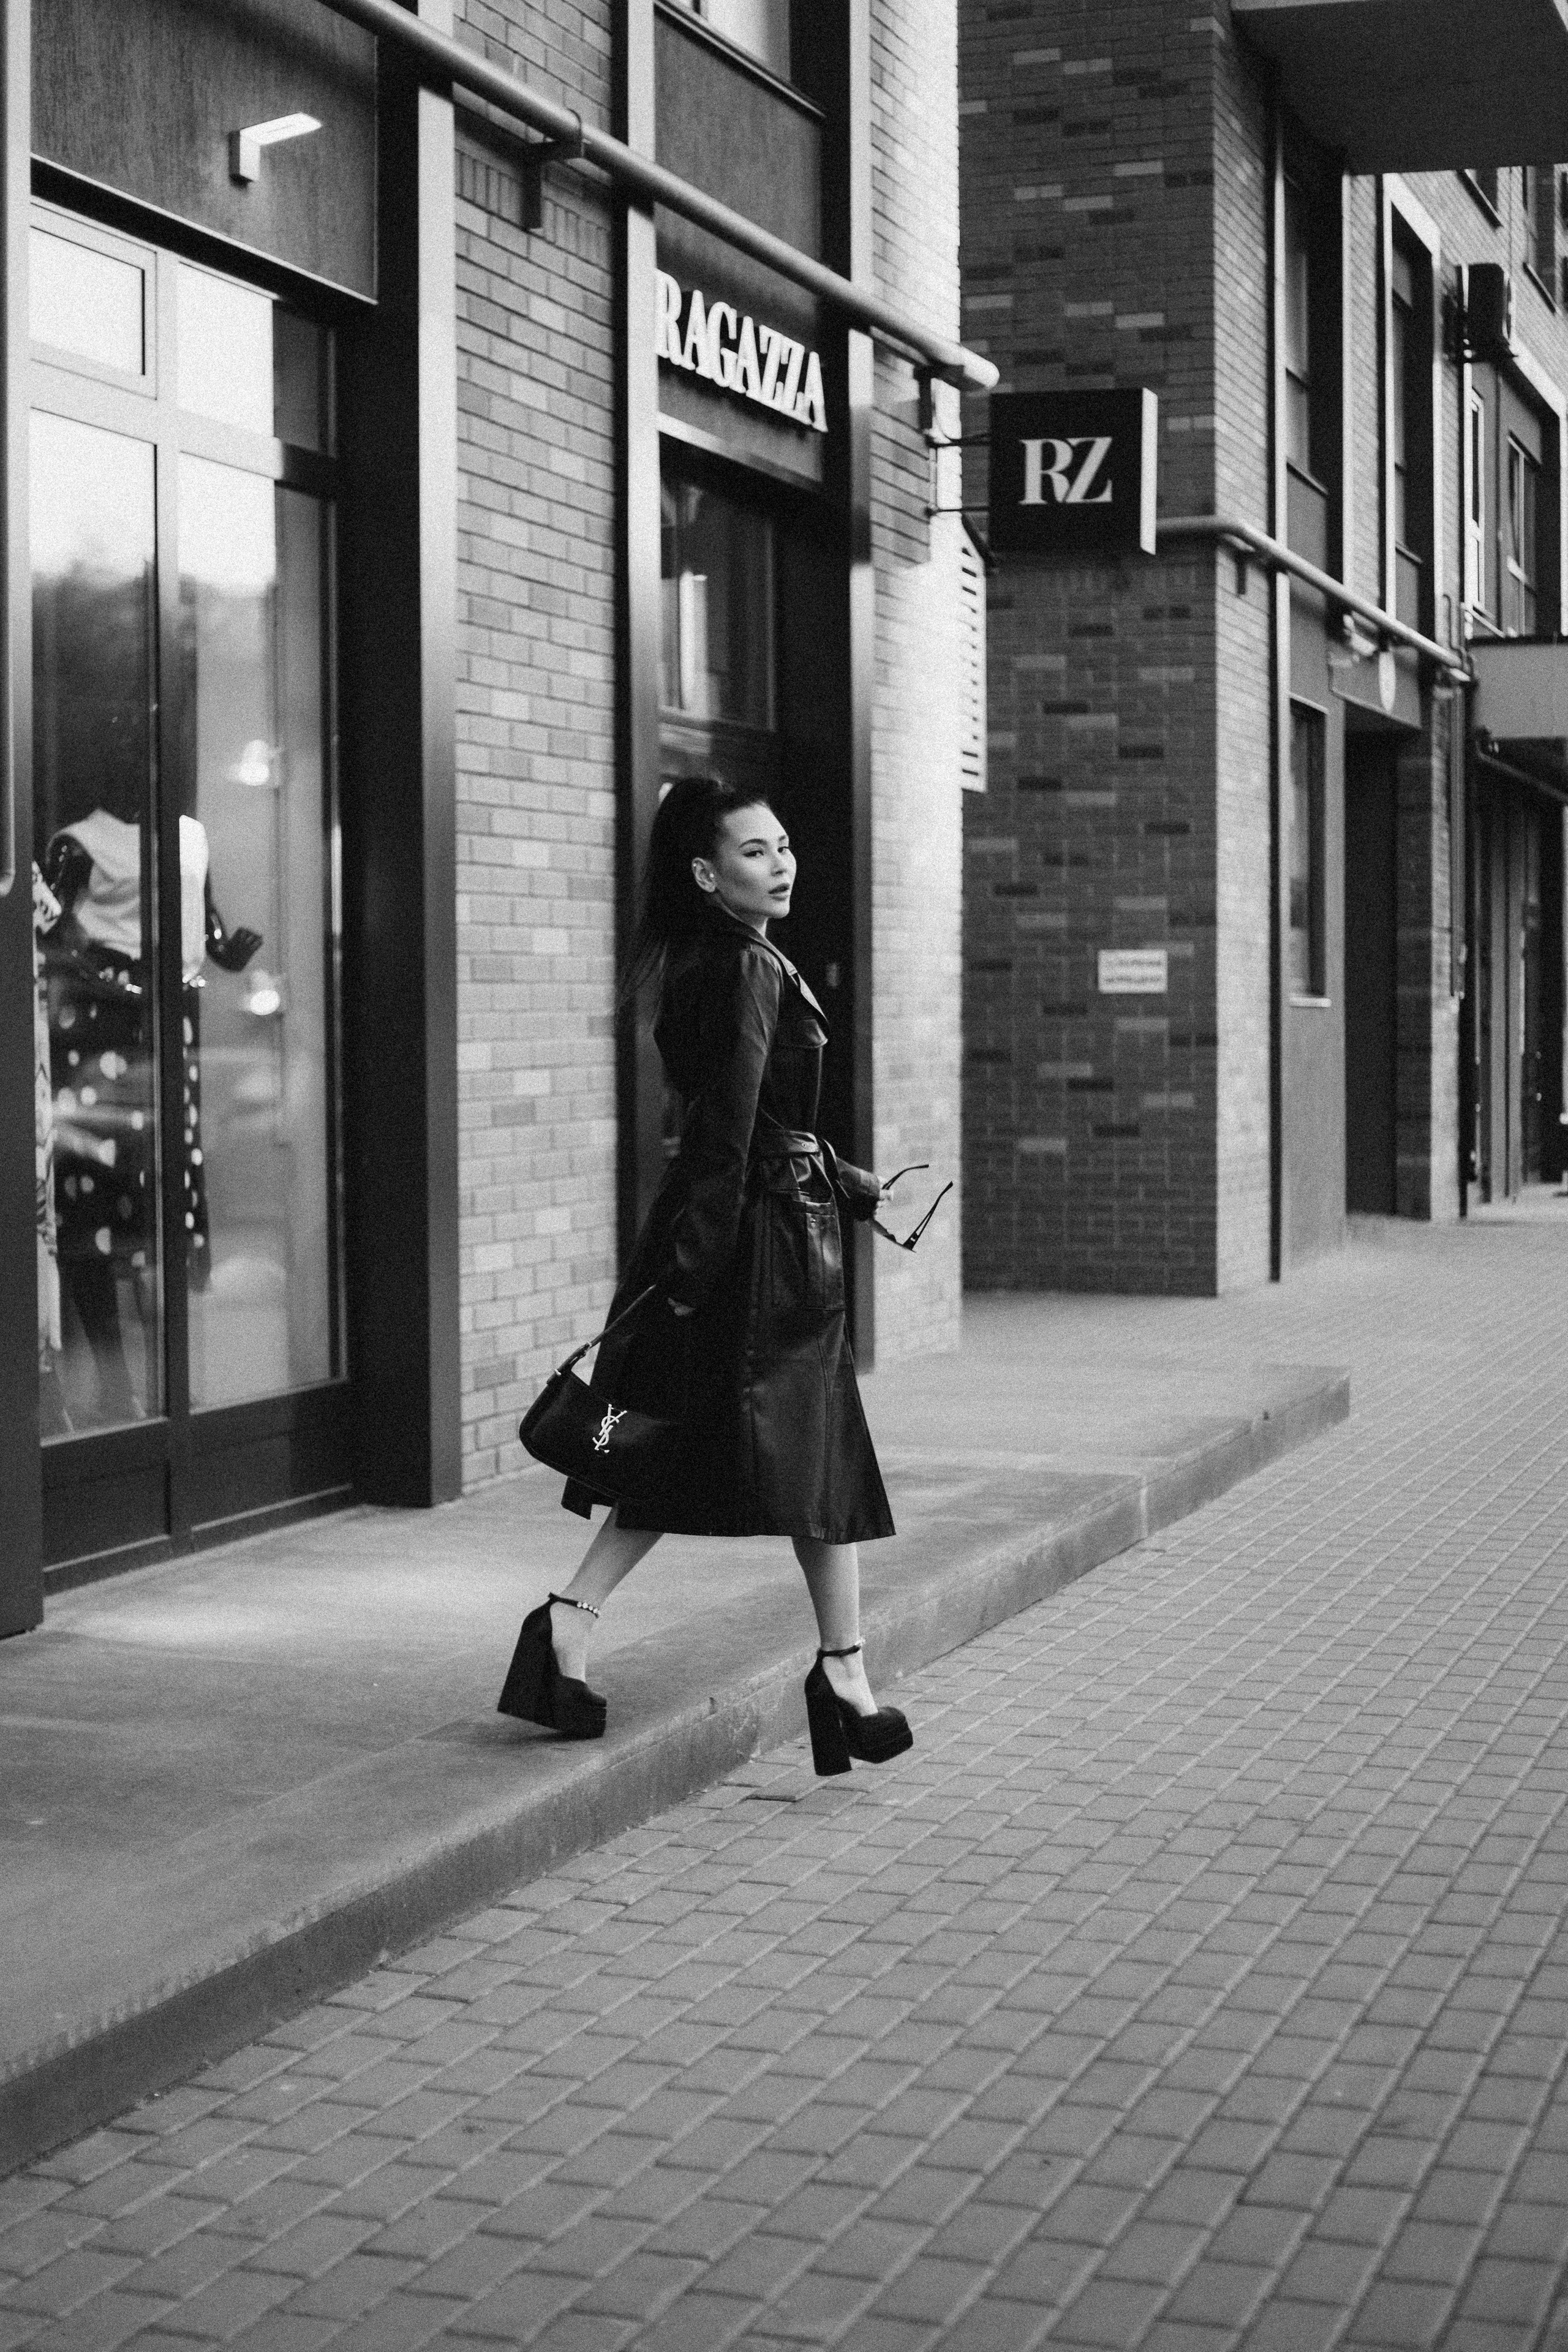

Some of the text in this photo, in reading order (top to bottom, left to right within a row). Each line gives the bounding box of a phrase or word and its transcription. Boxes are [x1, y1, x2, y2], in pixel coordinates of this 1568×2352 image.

[656, 268, 828, 432] RAGAZZA
[1019, 437, 1112, 505] RZ
[592, 1404, 628, 1453] YSL
